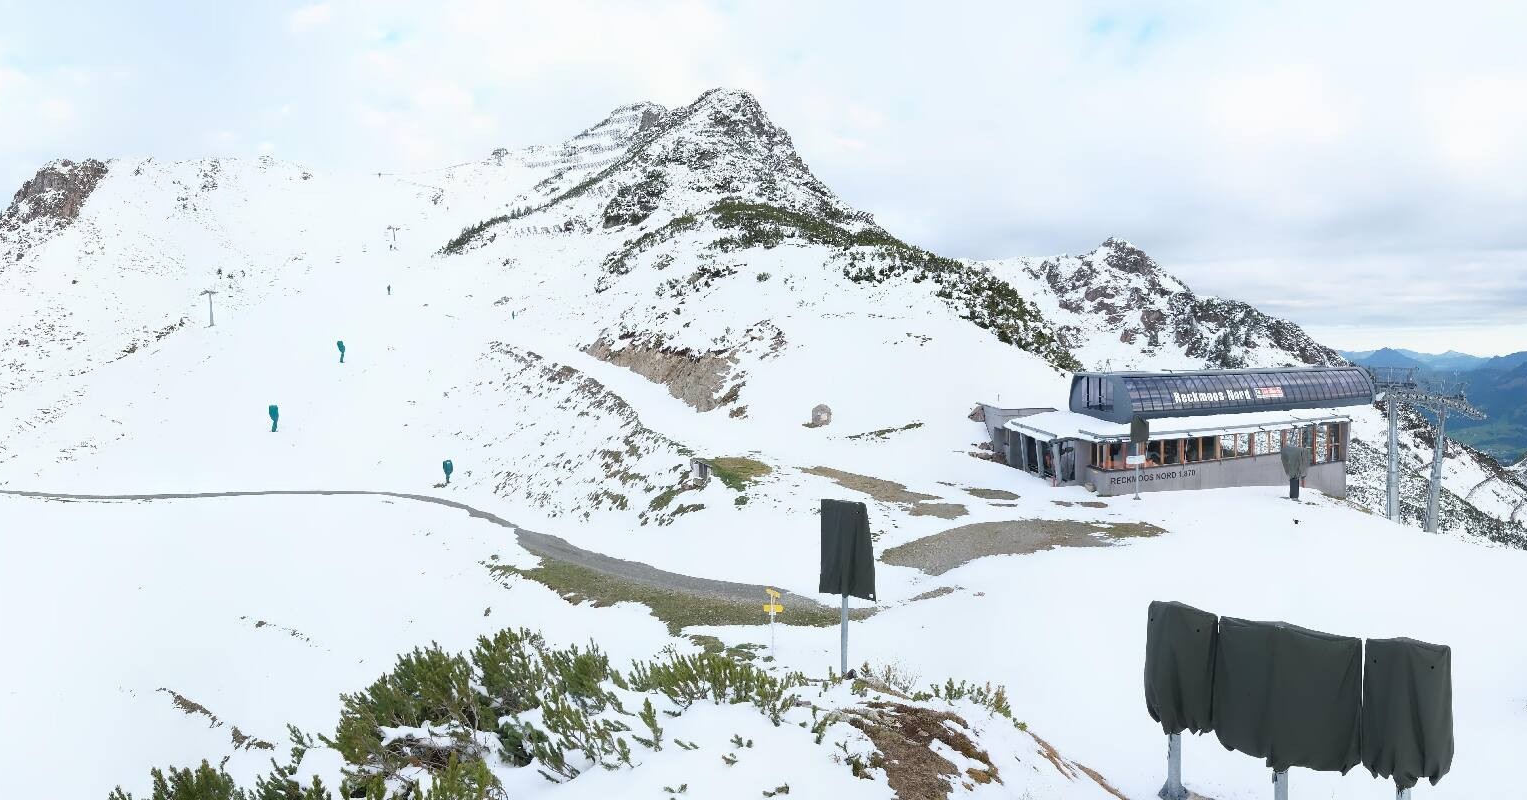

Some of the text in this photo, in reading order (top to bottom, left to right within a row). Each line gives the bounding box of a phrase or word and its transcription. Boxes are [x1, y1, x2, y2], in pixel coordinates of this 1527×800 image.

[1173, 391, 1225, 403] Reckmoos
[1226, 389, 1251, 401] Nord
[1156, 471, 1176, 480] NORD
